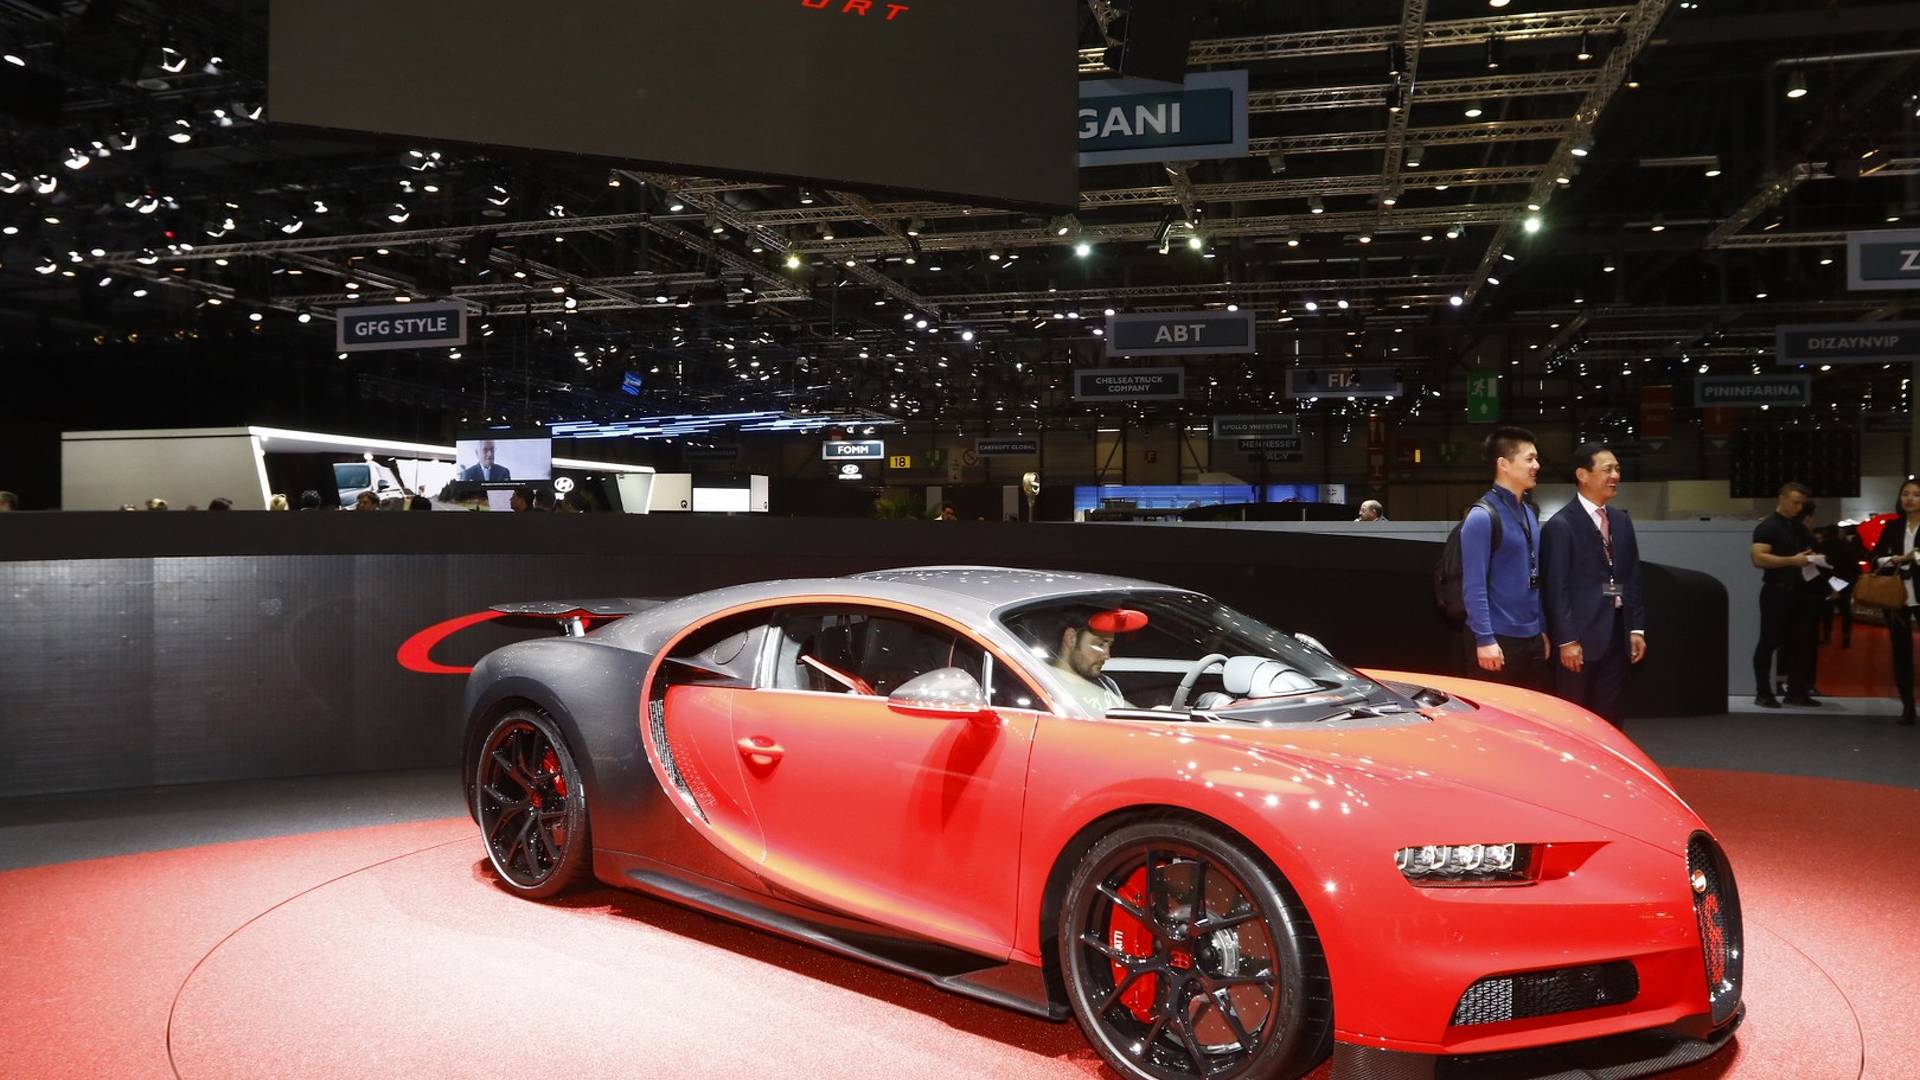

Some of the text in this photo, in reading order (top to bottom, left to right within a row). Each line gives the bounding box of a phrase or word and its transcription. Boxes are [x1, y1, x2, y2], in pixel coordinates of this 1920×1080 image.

[1079, 103, 1181, 139] GANI
[355, 317, 447, 335] GFG STYLE
[1154, 324, 1206, 343] ABT
[1808, 336, 1900, 350] DIZAYNVIP
[1096, 376, 1163, 385] CHELSEA TRUCK
[1705, 385, 1800, 397] PININFARINA
[838, 446, 869, 454] FOMM
[894, 457, 906, 467] 18
